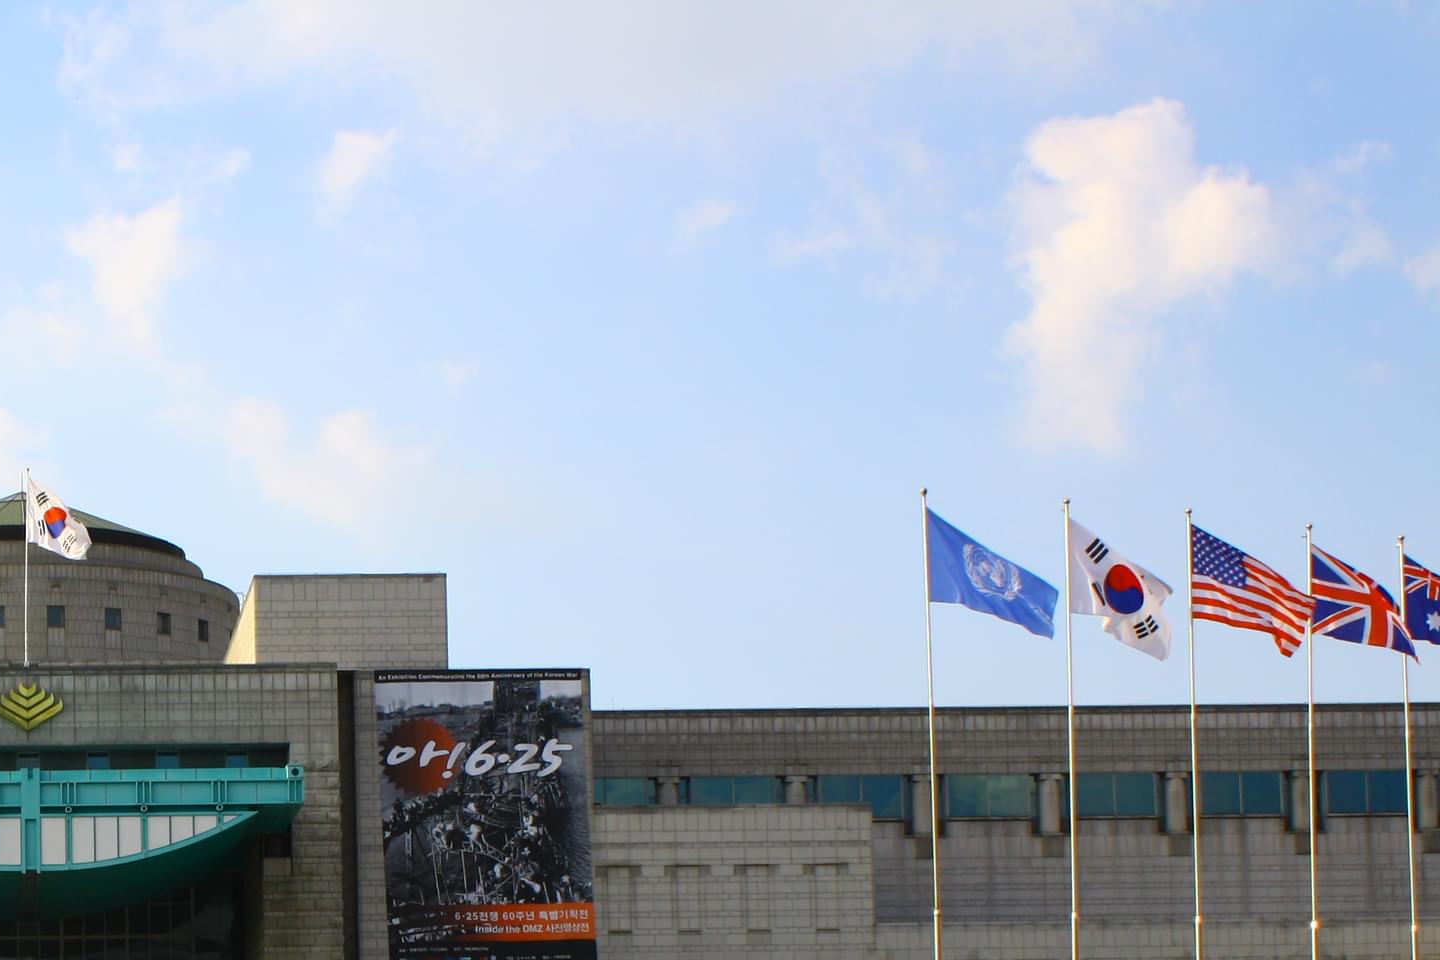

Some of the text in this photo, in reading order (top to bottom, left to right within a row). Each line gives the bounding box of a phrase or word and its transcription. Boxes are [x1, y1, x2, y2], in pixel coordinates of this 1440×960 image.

[502, 911, 535, 921] 60주년
[475, 924, 504, 934] Inside
[505, 924, 520, 933] the
[522, 924, 543, 933] DMZ
